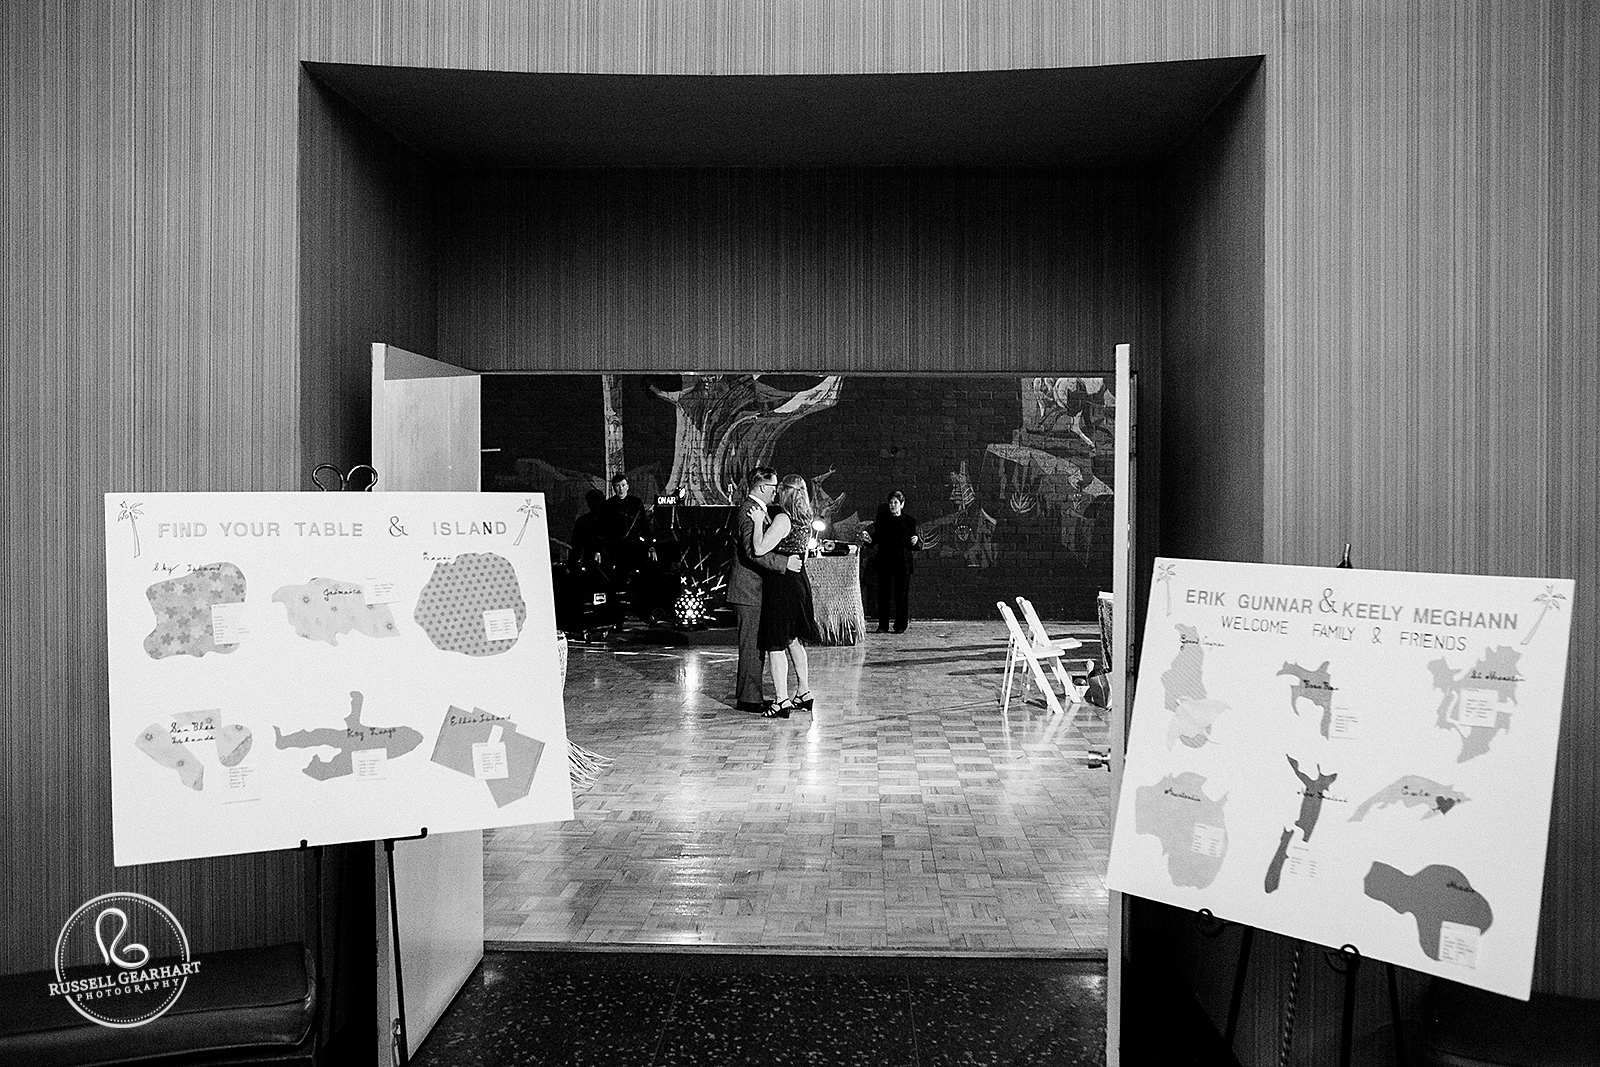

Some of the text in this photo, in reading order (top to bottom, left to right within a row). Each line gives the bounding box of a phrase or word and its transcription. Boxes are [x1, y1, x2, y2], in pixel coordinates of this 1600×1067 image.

[158, 515, 507, 538] FIND YOUR TABLE & ISLAND
[152, 562, 180, 577] Sky
[1186, 588, 1518, 630] ERIK GUNNAR & KEELY MEGHANN
[1221, 615, 1467, 651] WELCOME FAMILY & FRIENDS
[170, 722, 215, 734] San Blas
[171, 734, 216, 744] Islands
